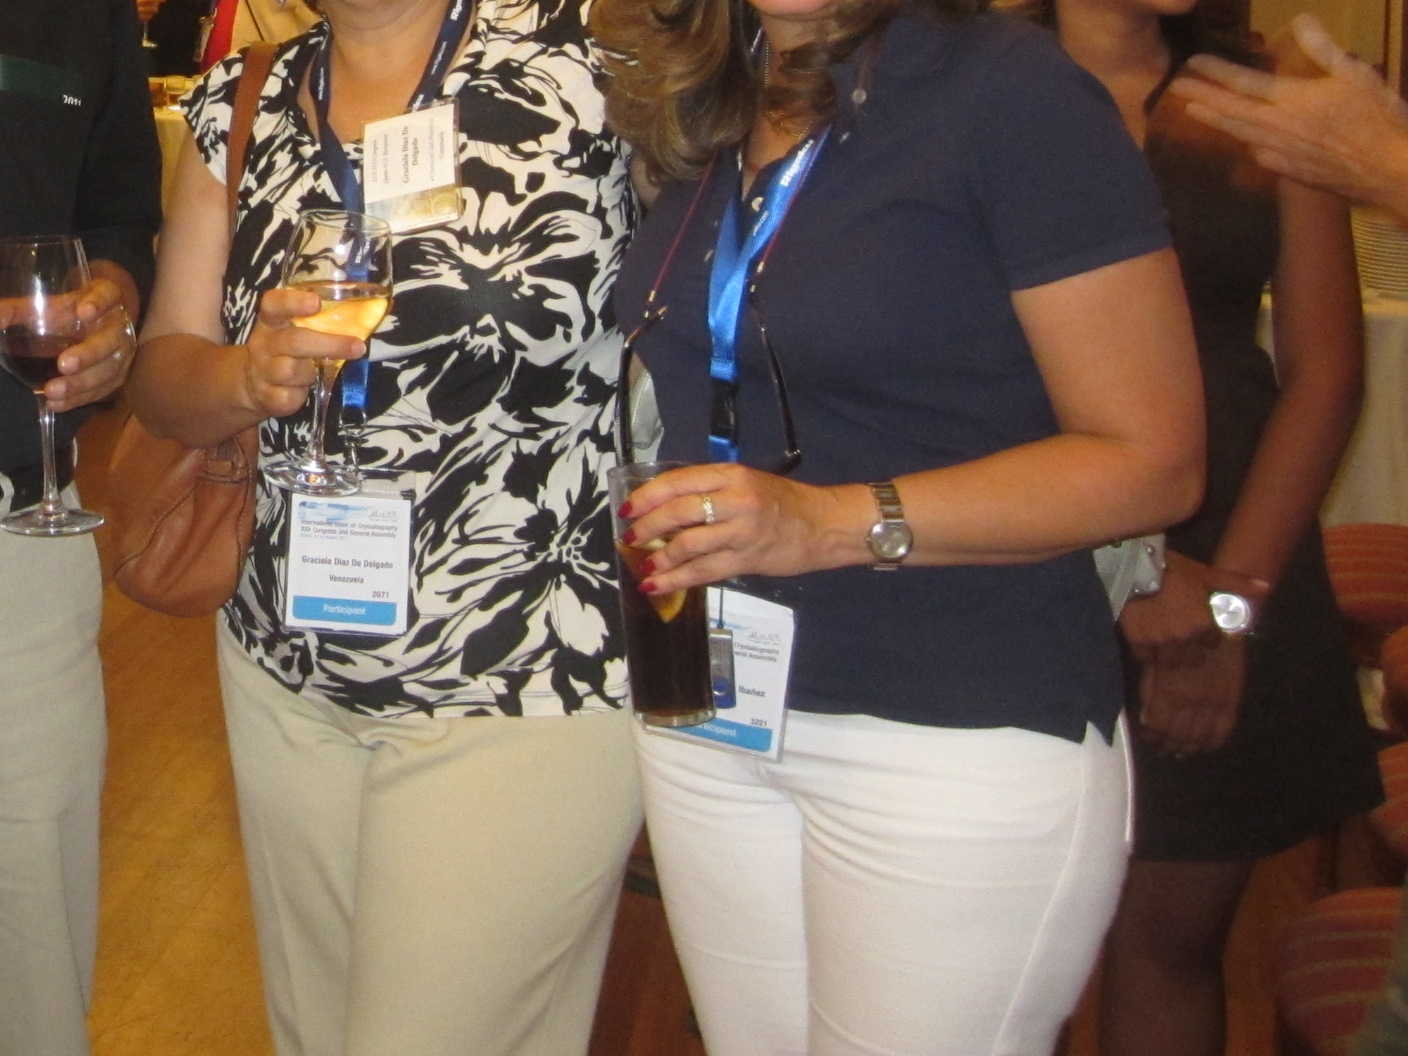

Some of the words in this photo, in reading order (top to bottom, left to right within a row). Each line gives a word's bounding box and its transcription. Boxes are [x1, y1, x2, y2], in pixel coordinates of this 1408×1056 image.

[302, 555, 332, 565] Graciela
[351, 558, 362, 567] De
[363, 560, 393, 570] Delgado
[329, 574, 364, 584] Venezuela
[323, 603, 366, 615] Participant
